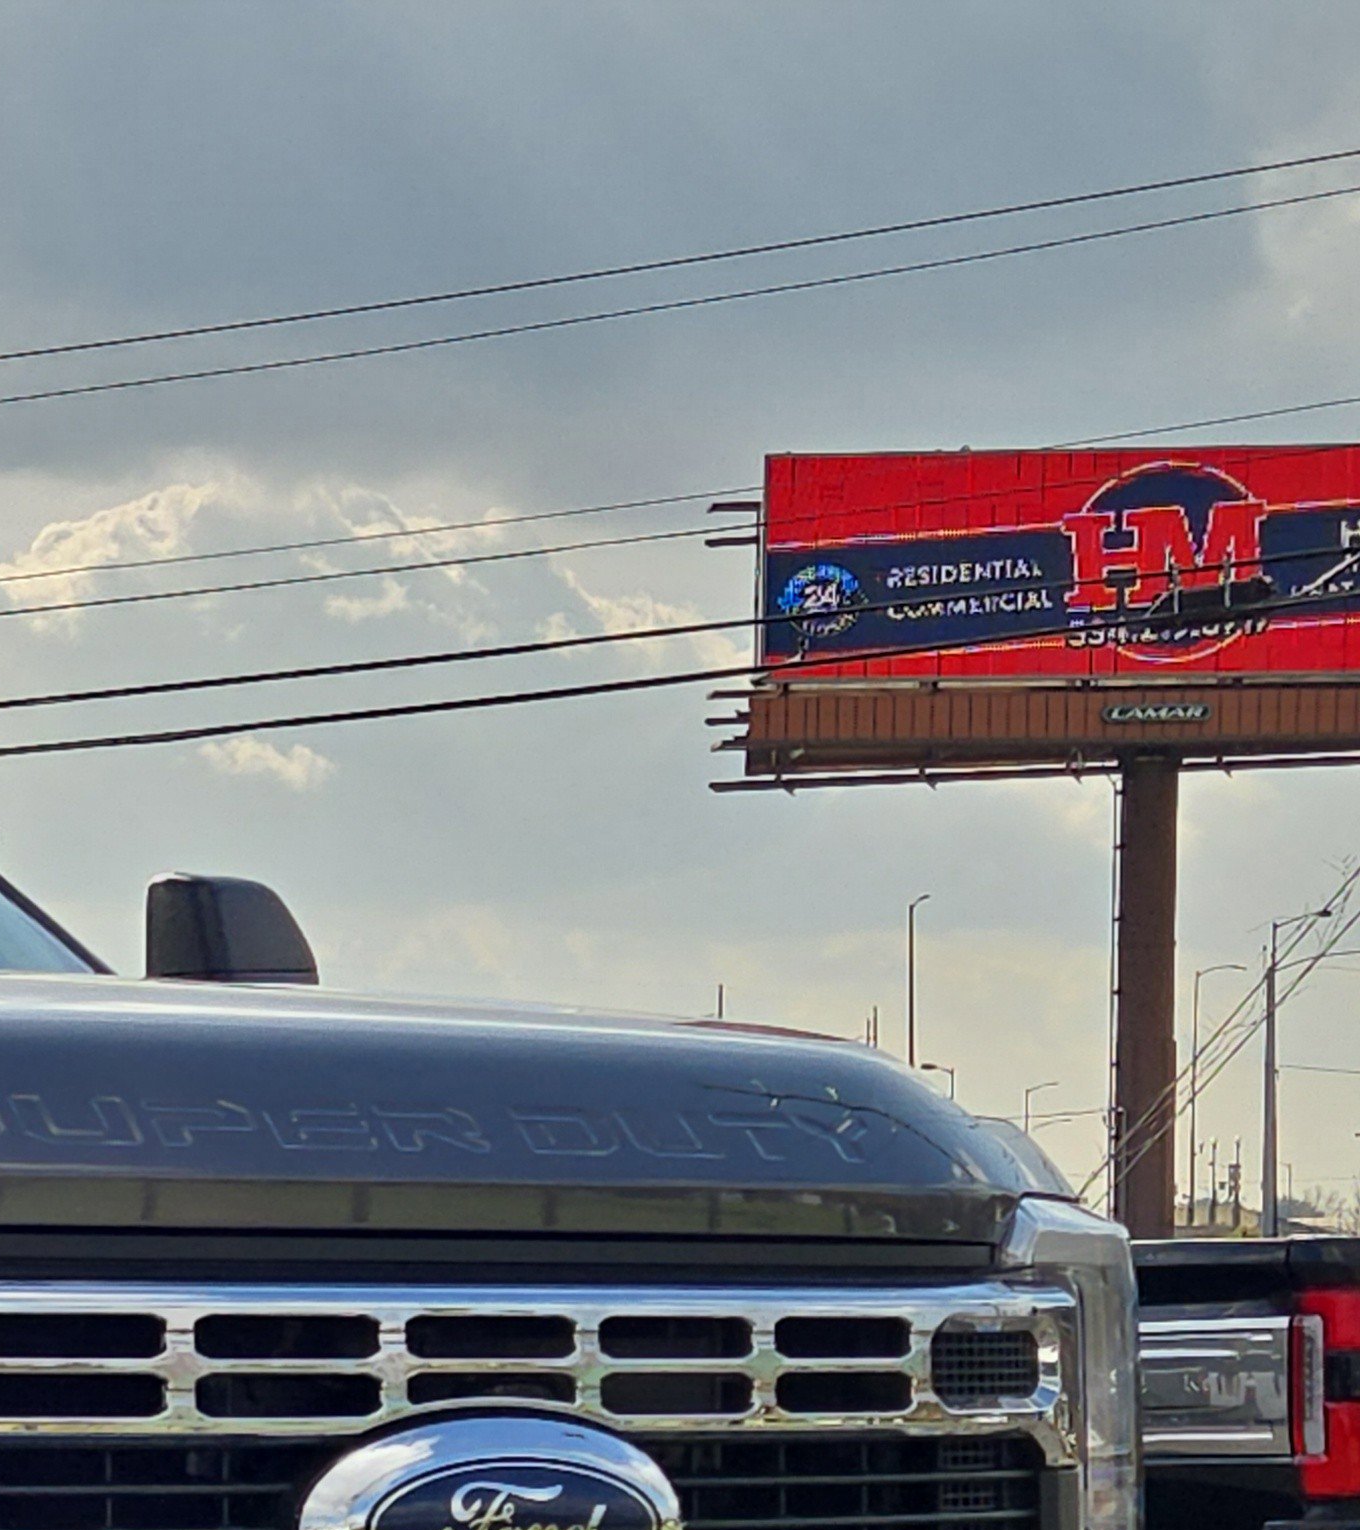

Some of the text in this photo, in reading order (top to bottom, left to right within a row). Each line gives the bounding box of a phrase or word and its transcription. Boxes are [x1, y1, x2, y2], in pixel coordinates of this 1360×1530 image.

[885, 558, 1043, 589] RESIDENTIAL
[1109, 706, 1205, 720] LAMAR
[506, 1106, 868, 1164] DUTY
